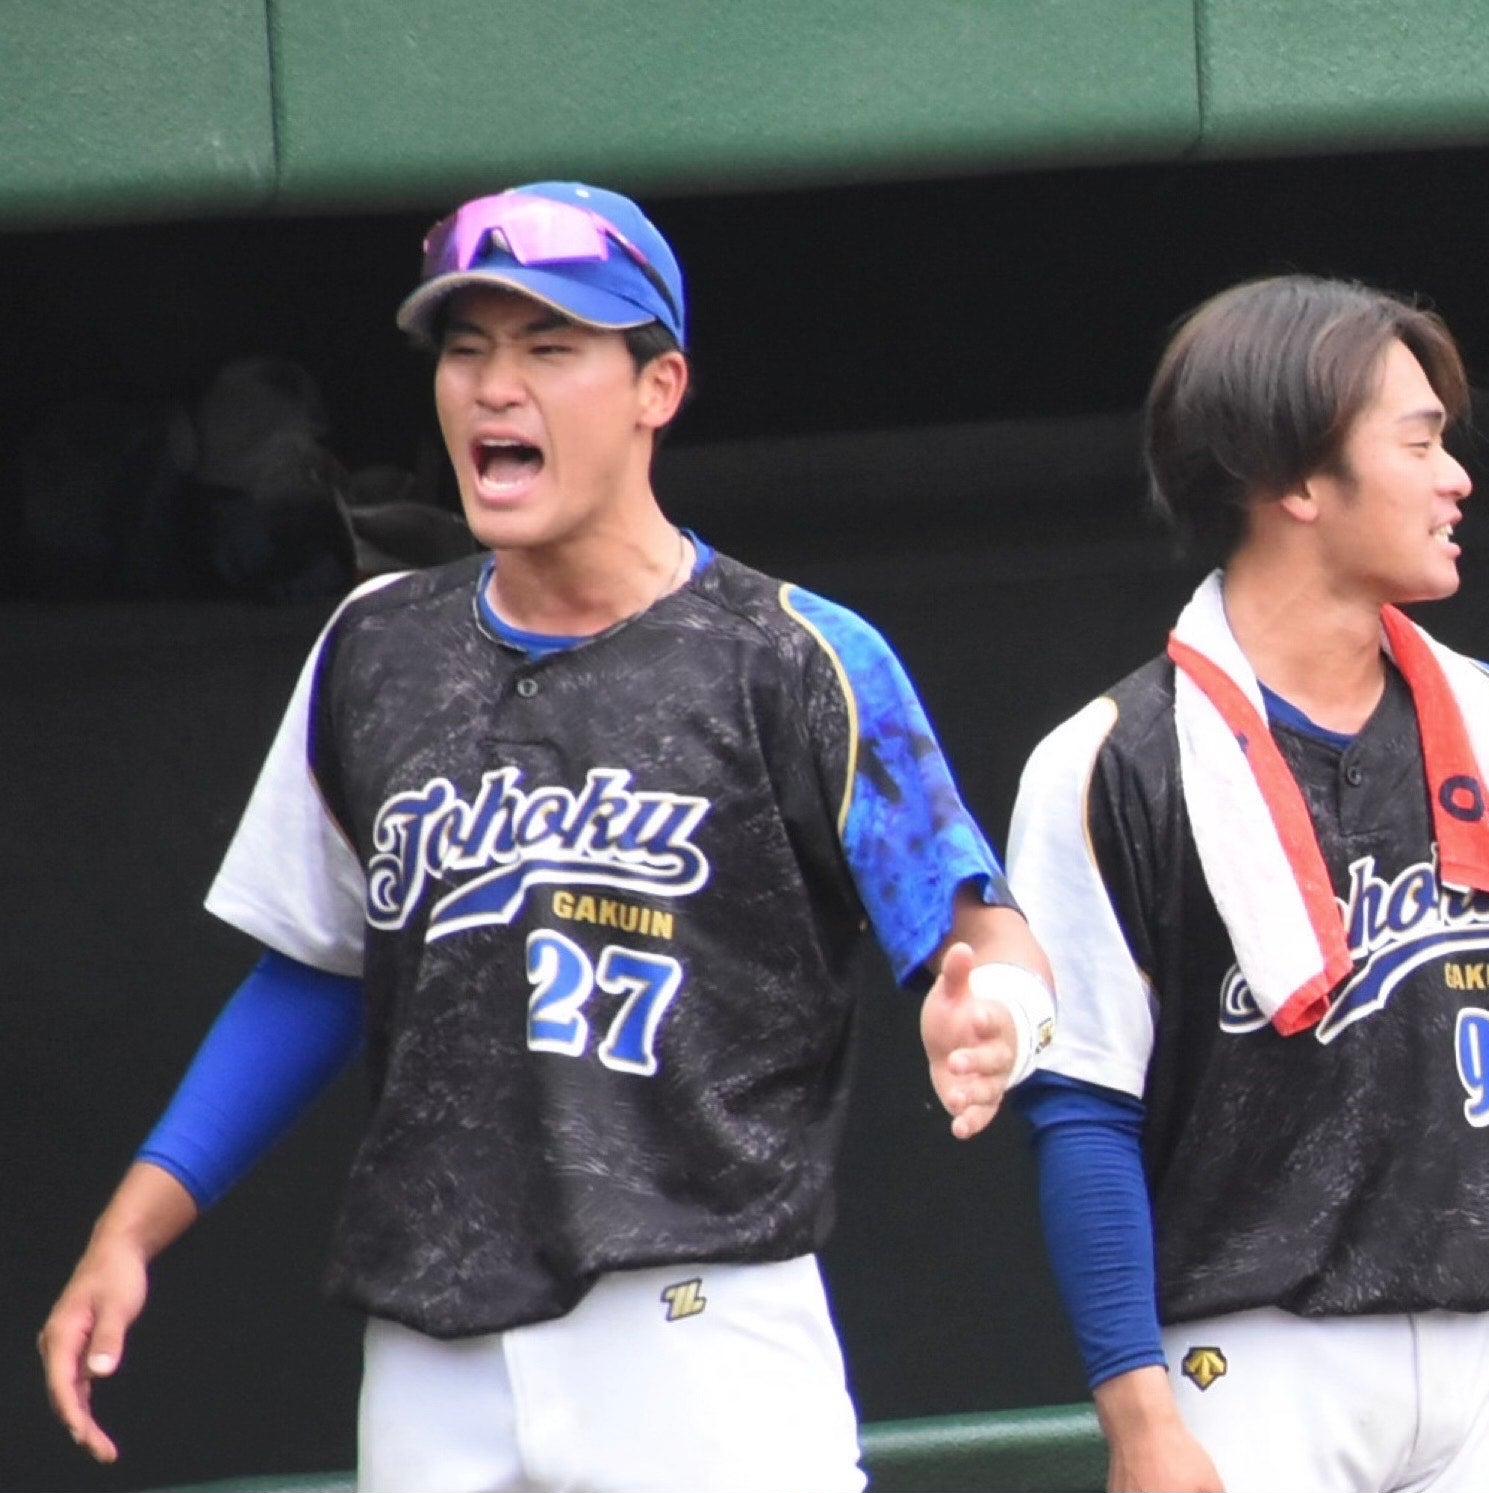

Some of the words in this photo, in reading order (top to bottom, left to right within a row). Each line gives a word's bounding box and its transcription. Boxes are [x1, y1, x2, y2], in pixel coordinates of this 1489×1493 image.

[367, 766, 711, 930] Tohoku
[552, 889, 674, 941] GAKUIN
[526, 929, 682, 1076] 27
